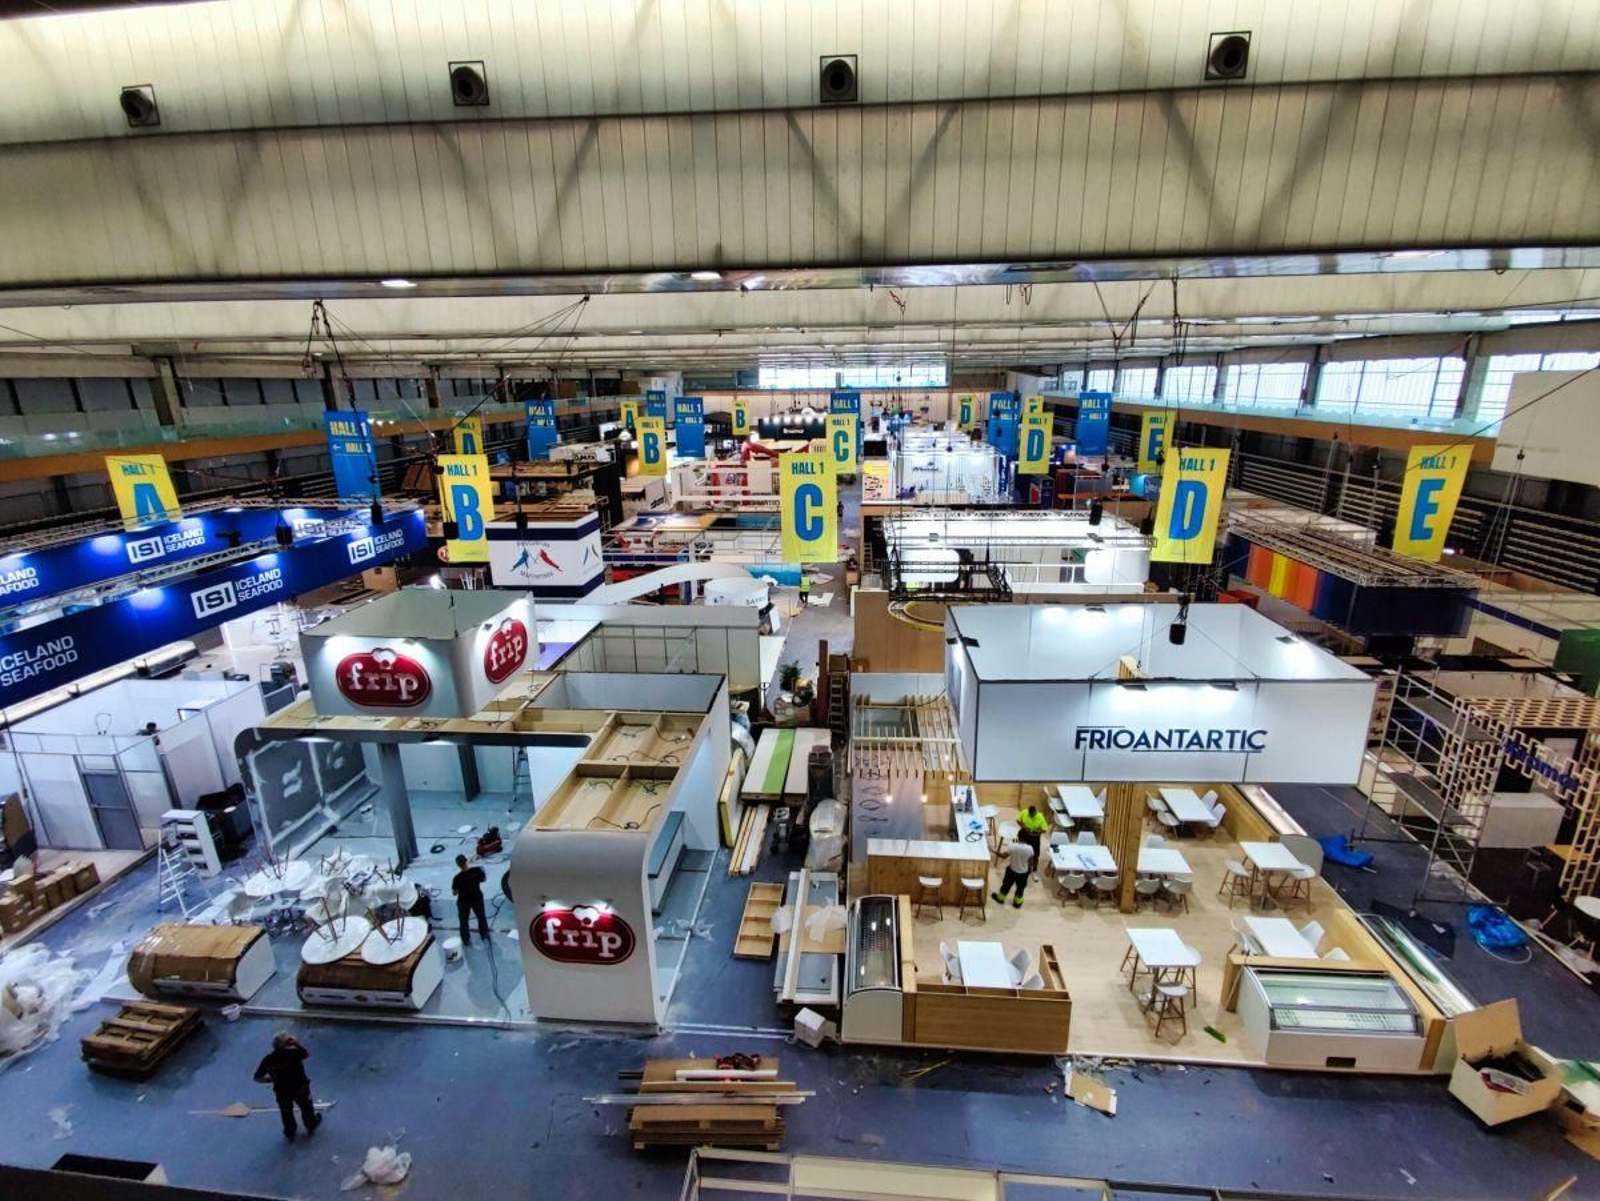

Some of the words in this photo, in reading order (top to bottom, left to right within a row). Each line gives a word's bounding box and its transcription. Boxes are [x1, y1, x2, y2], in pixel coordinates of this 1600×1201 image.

[528, 405, 545, 415] HALL
[548, 406, 552, 415] 1
[677, 403, 694, 413] HALL
[697, 404, 701, 413] 1
[833, 399, 851, 408] HALL
[853, 399, 858, 408] 1
[992, 399, 1011, 409] HALL
[1082, 399, 1101, 408] HALL
[1104, 399, 1108, 408] 1
[625, 410, 635, 428] A
[736, 409, 745, 428] B
[960, 405, 971, 424] D
[1029, 417, 1042, 425] HALL
[1149, 416, 1163, 424] HALL
[330, 420, 358, 437] HALL
[360, 421, 367, 437] 1
[642, 421, 655, 429] HALL
[345, 442, 364, 453] HALL
[462, 433, 476, 454] A
[643, 432, 659, 464] B
[833, 430, 849, 462] C
[1026, 429, 1044, 462] D
[1148, 428, 1164, 461] E
[121, 464, 148, 476] HALL
[150, 463, 155, 475] 1
[446, 464, 470, 477] HALL
[473, 465, 477, 476] 1
[791, 462, 816, 475] HALL
[819, 462, 824, 474] 1
[1179, 458, 1205, 471] HALL
[1210, 459, 1216, 471] 1
[1420, 455, 1447, 469] HALL
[1450, 455, 1457, 468] 1
[133, 483, 171, 527] A
[451, 485, 484, 541] B
[794, 483, 824, 542] C
[1168, 480, 1208, 541] D
[1408, 479, 1446, 541] E
[164, 528, 204, 544] ICELAND
[166, 537, 206, 553] SEAFOOD
[374, 528, 403, 545] ICELAND
[130, 538, 164, 560] ISI
[350, 539, 374, 560] ISI
[375, 538, 405, 554] SEAFOOD
[236, 568, 281, 591] ICELAND
[195, 585, 233, 613] ISI
[238, 579, 284, 602] SEAFOOD
[490, 635, 524, 671] frip
[1, 650, 79, 687] SEAFOOD
[347, 662, 419, 700] frip
[1074, 728, 1269, 750] FRIOANTARTIC
[542, 917, 622, 958] frip
